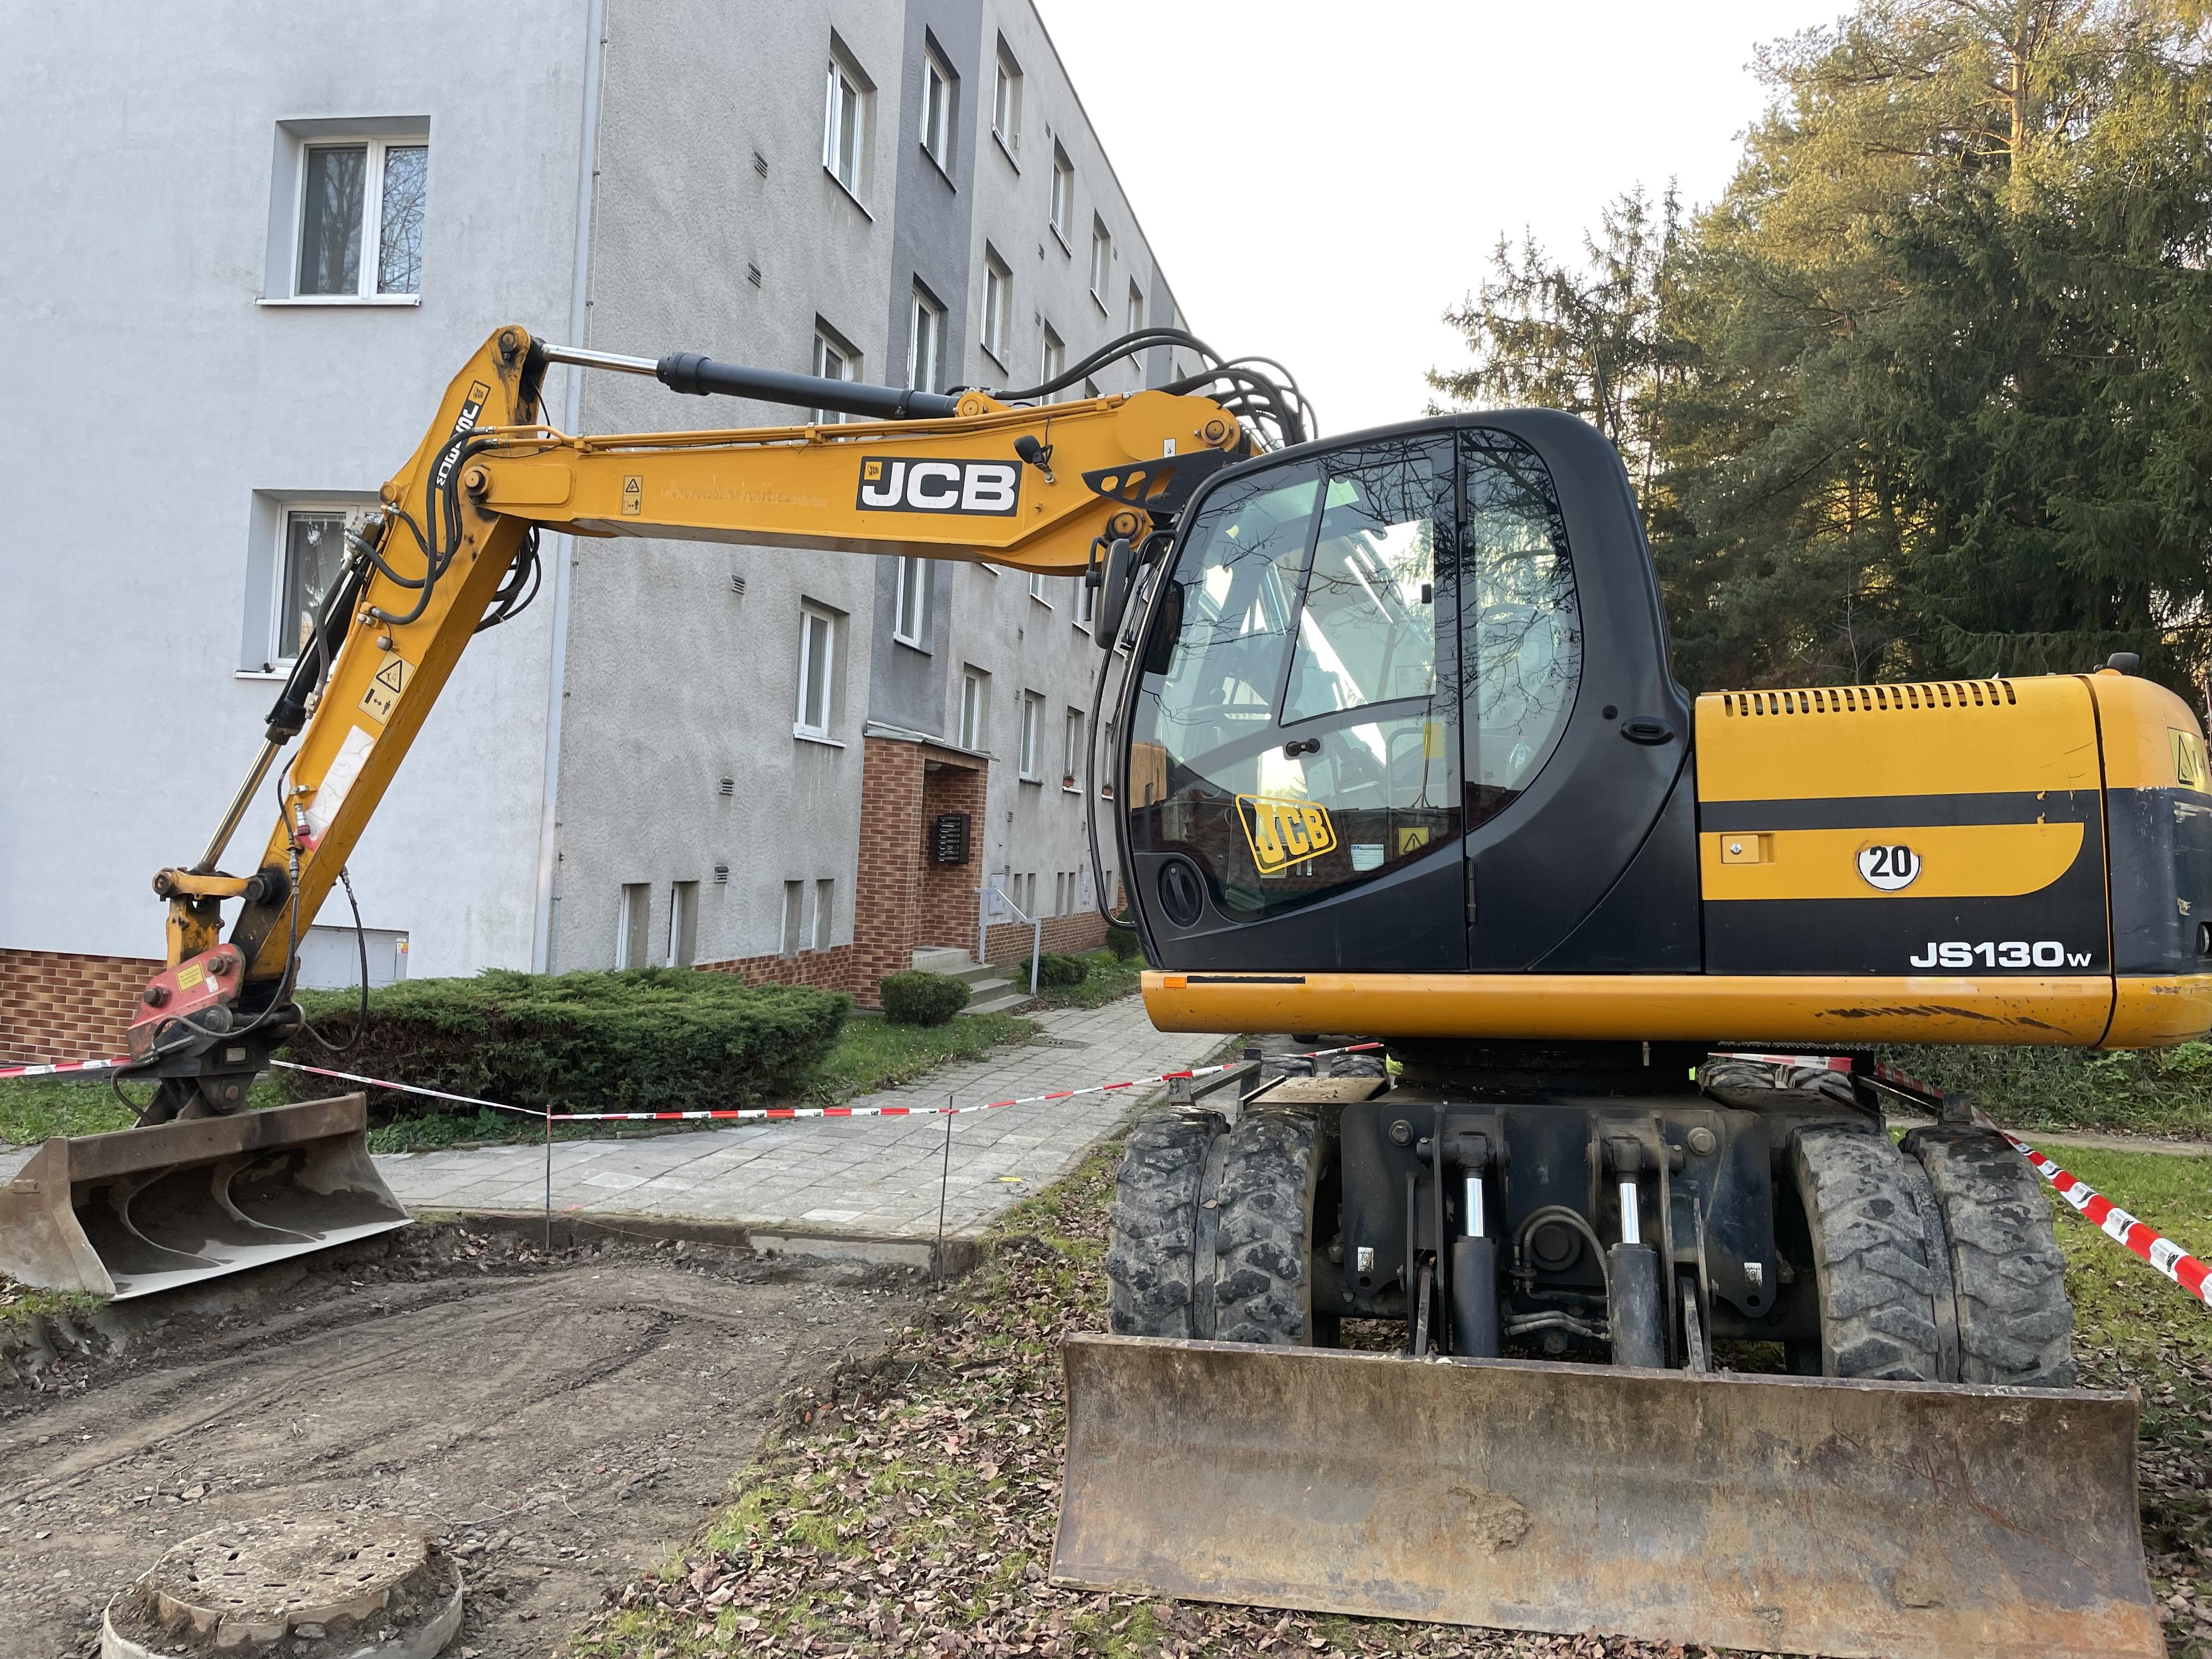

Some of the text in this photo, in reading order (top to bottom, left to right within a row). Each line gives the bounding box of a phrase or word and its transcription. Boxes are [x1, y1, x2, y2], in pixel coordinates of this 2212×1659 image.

[862, 462, 1016, 511] JCB
[1253, 803, 1329, 864] JCB
[1870, 846, 1911, 877] 20
